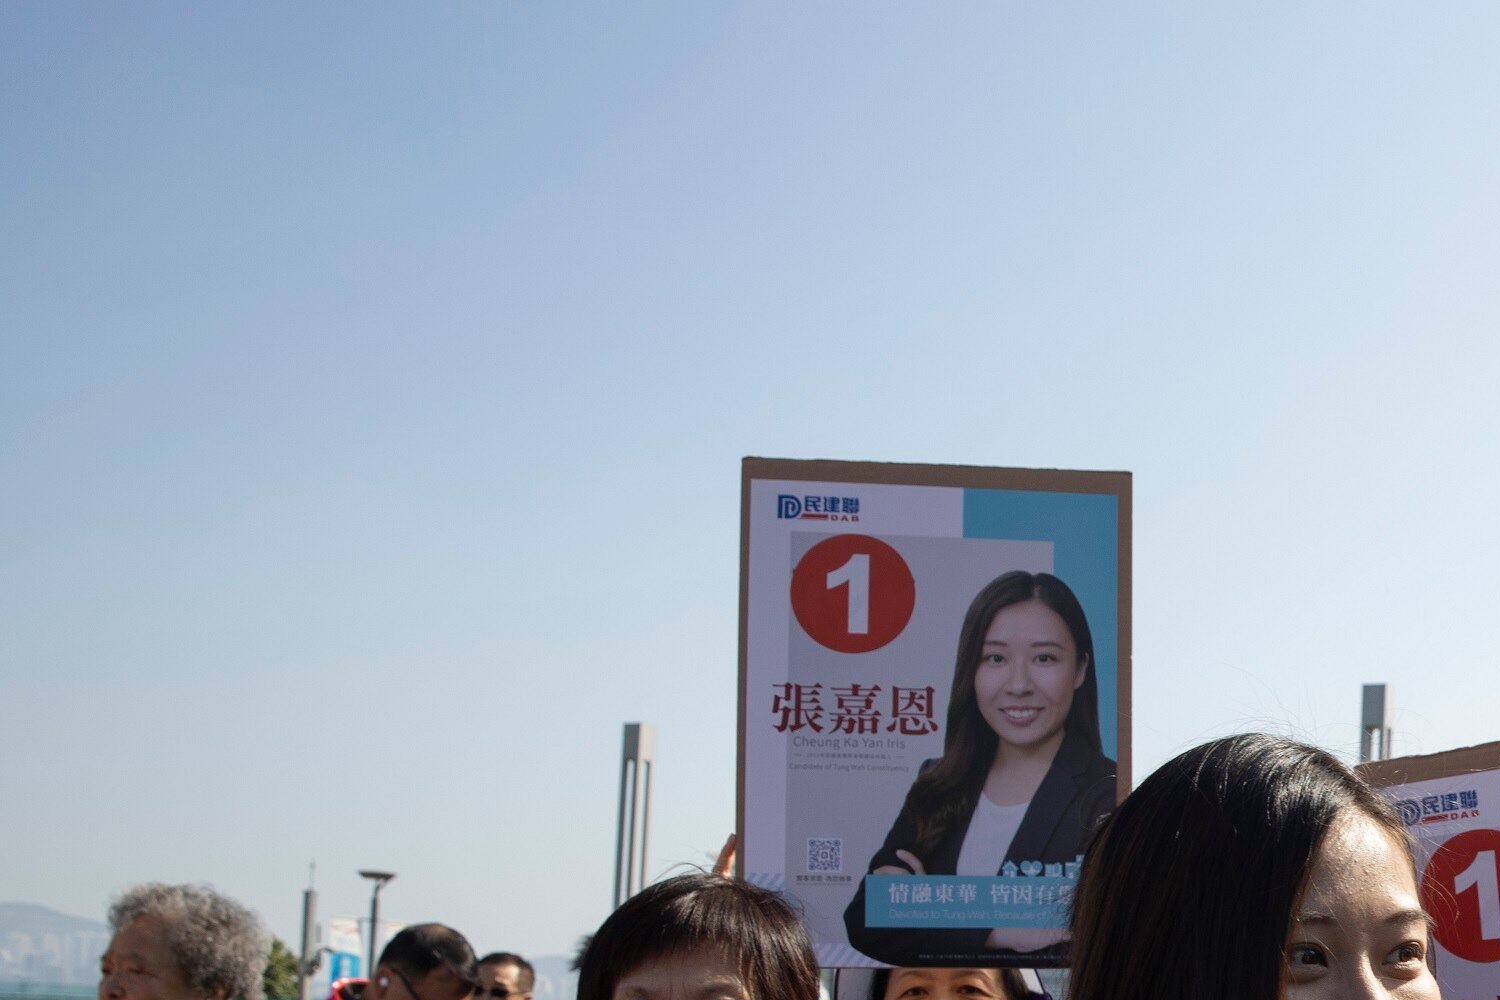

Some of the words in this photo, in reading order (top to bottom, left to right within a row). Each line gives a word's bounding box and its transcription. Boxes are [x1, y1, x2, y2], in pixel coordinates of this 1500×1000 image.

[830, 514, 860, 522] DAB
[825, 553, 870, 635] 1
[771, 682, 939, 736] 張嘉恩
[792, 736, 840, 750] Cheung
[843, 737, 860, 749] Ka
[862, 737, 884, 749] Yan
[887, 737, 906, 749] Iris
[1451, 808, 1479, 820] DAB
[889, 882, 977, 904] 情融東華
